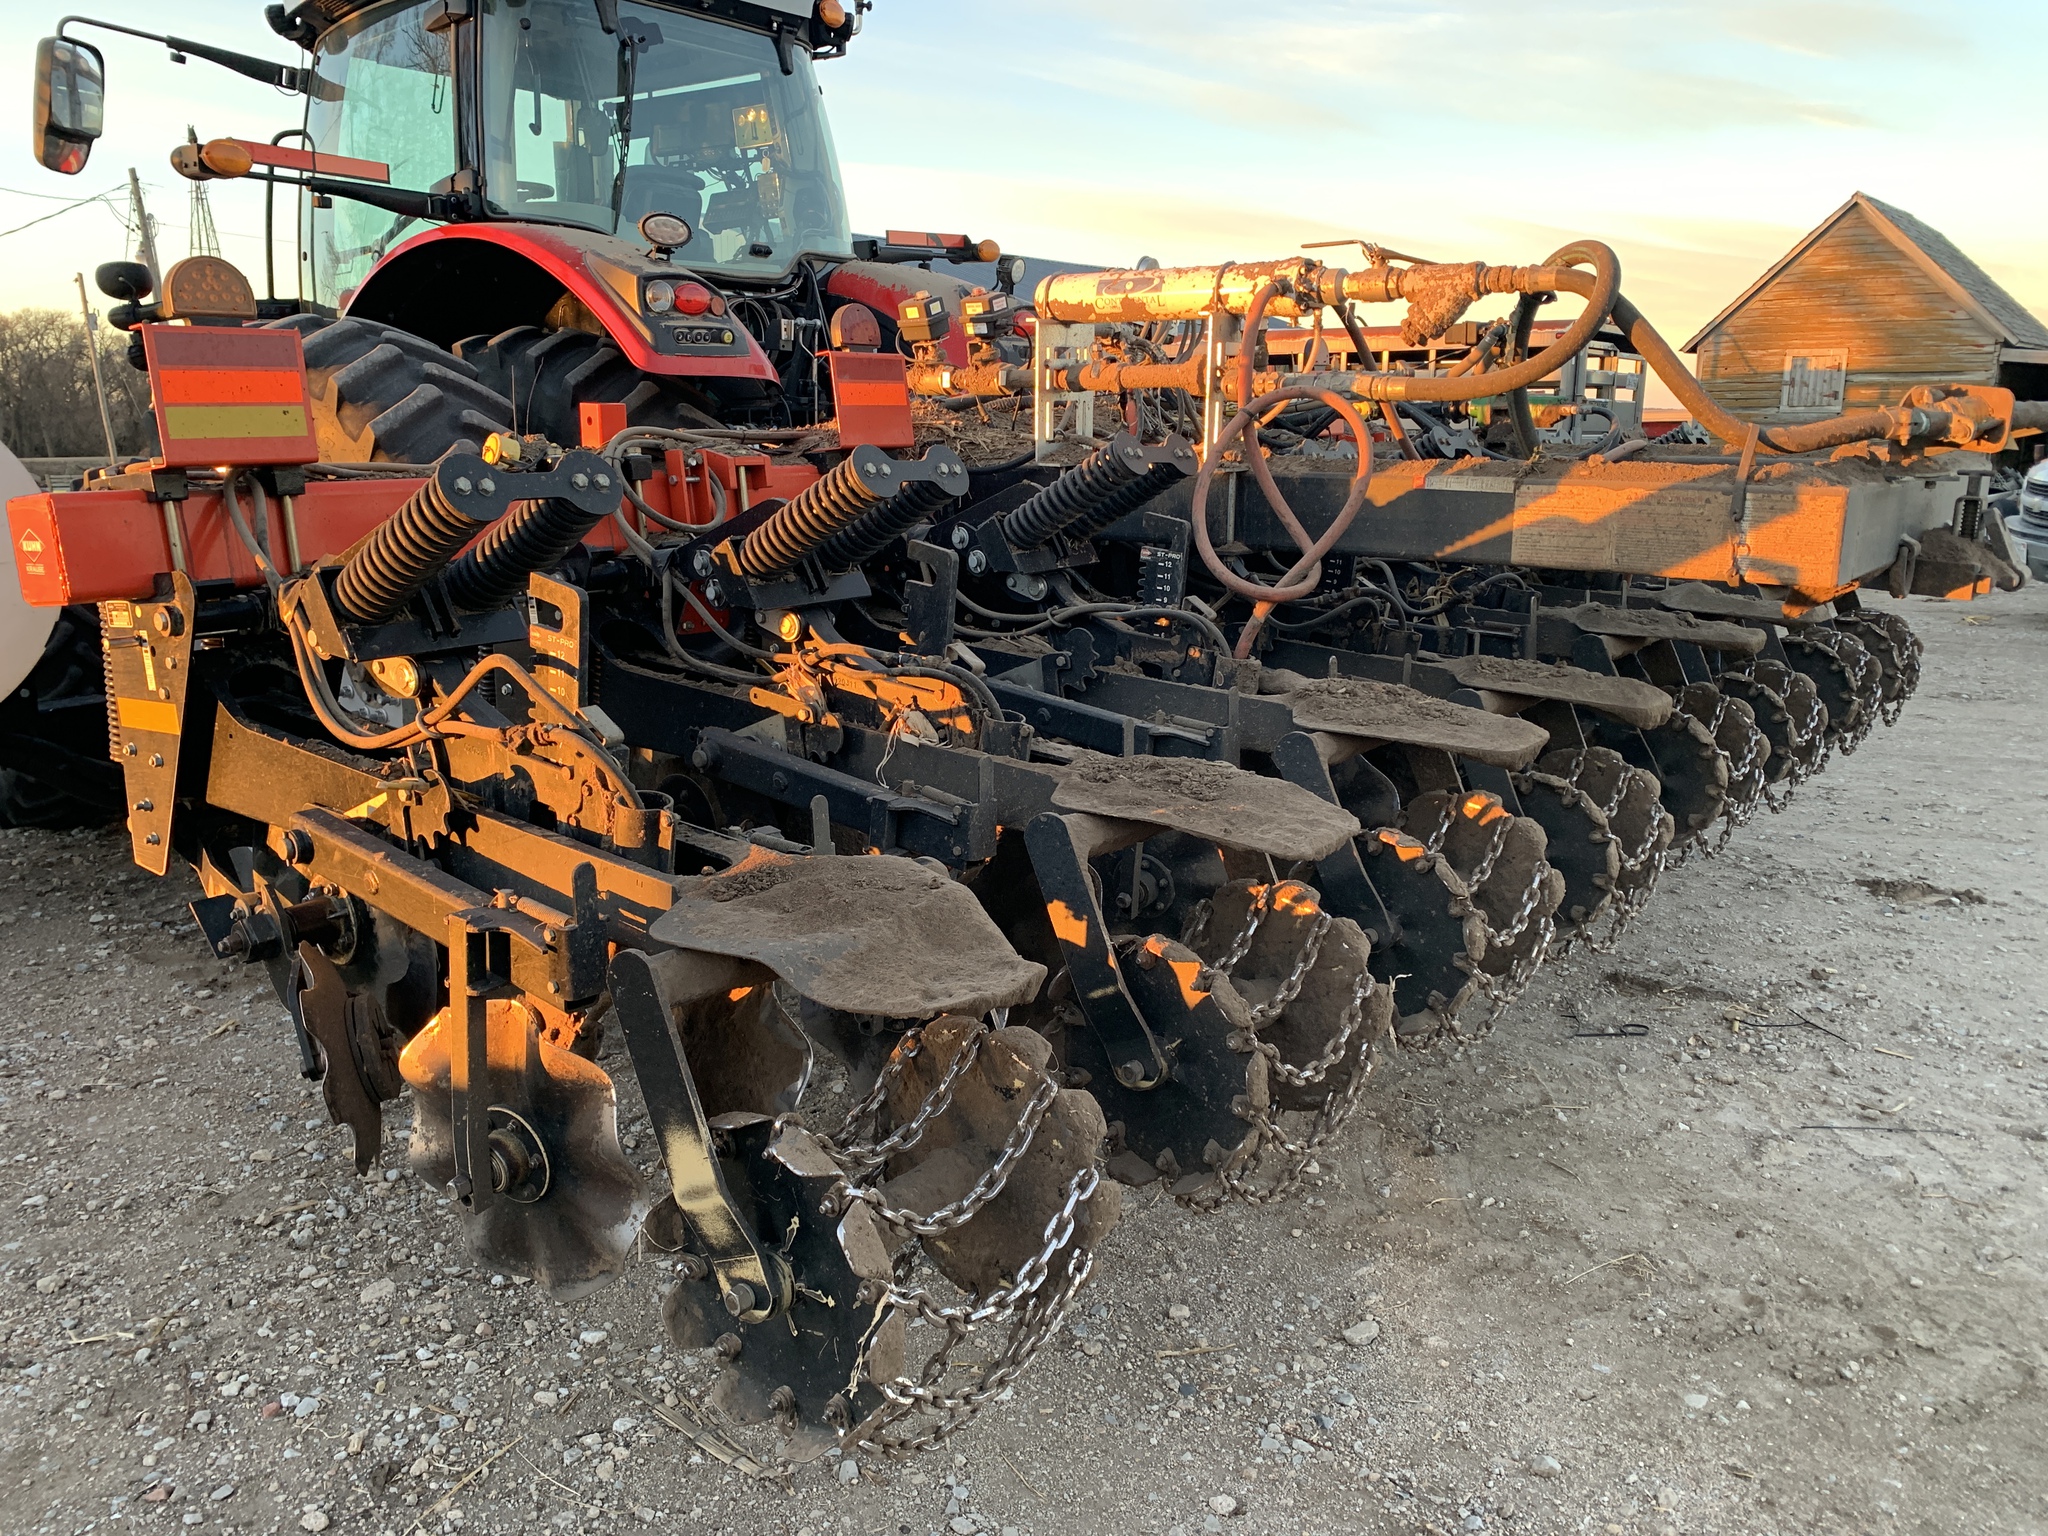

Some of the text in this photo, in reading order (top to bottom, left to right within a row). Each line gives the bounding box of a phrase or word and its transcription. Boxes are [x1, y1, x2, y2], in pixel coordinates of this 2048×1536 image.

[22, 540, 42, 552] KUHN
[1156, 551, 1182, 560] ST-PRO
[1163, 584, 1171, 592] 10
[547, 634, 575, 649] ST-PRO
[557, 650, 565, 660] 12
[557, 668, 565, 679] 11
[557, 686, 566, 697] 10
